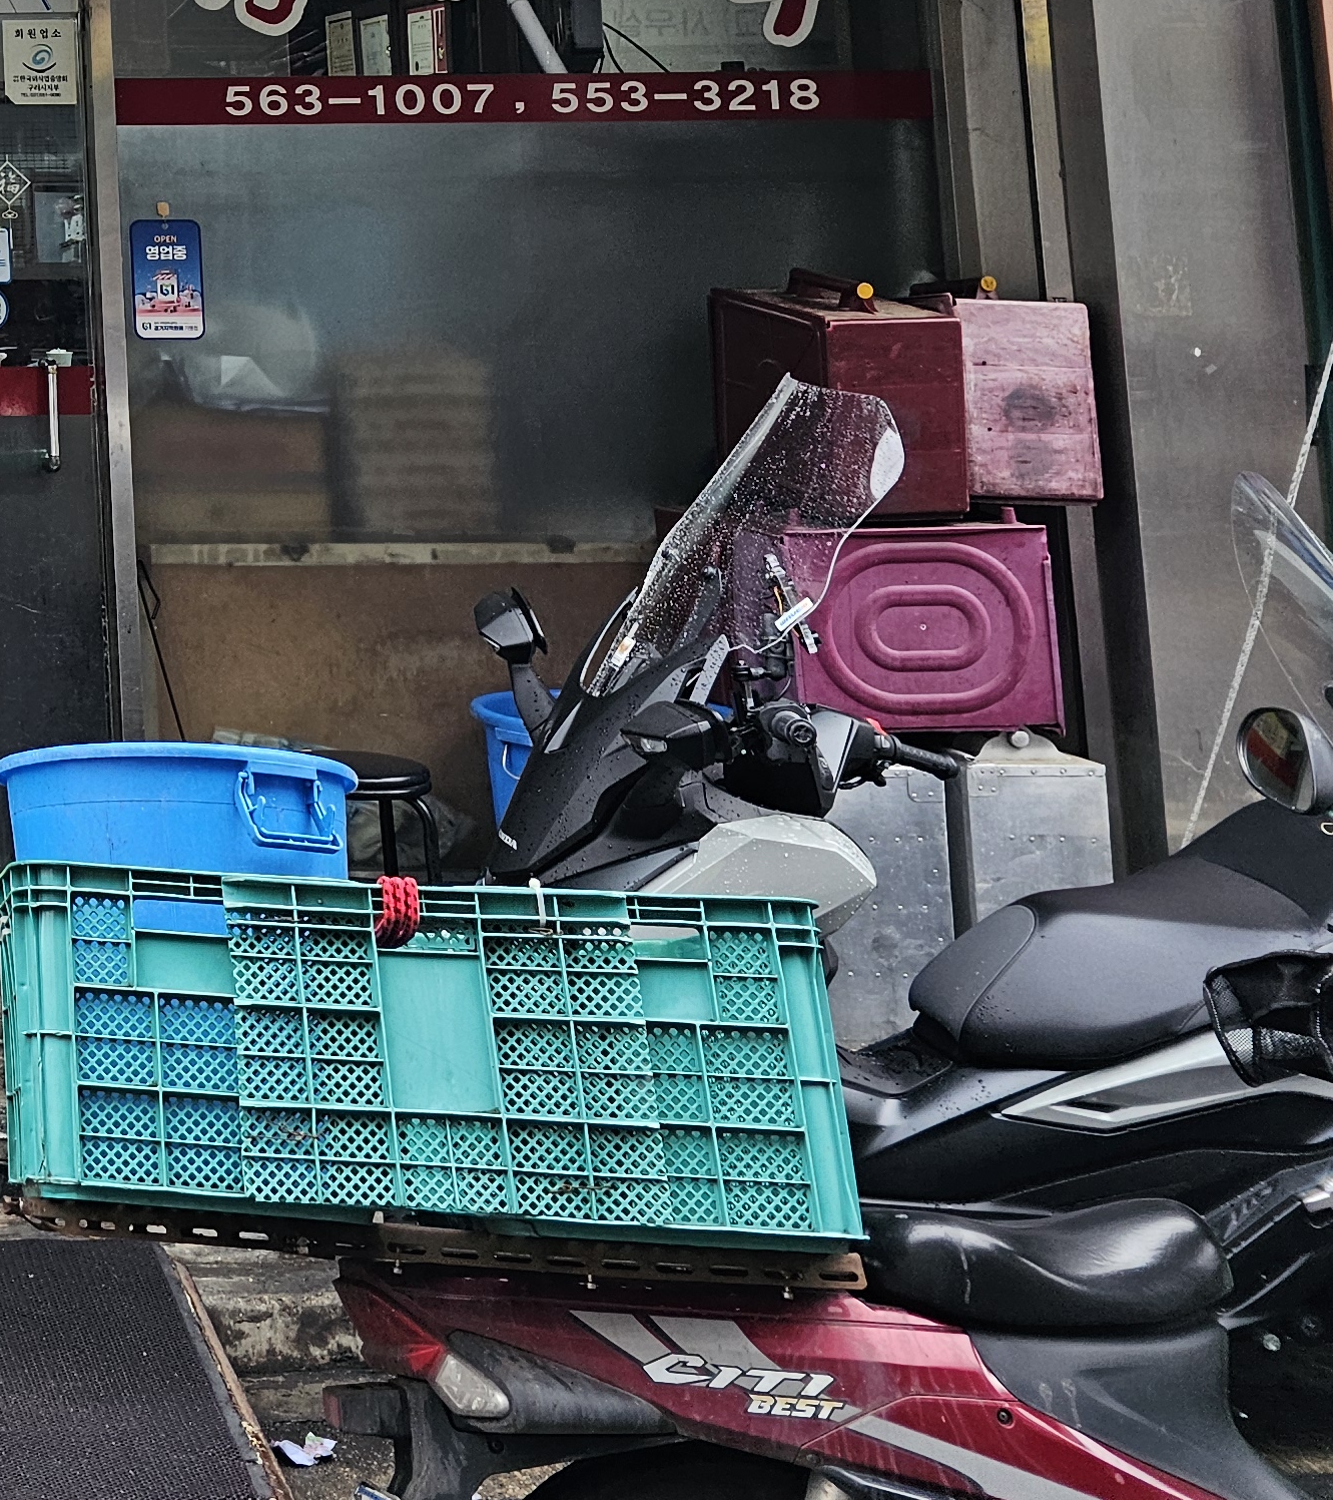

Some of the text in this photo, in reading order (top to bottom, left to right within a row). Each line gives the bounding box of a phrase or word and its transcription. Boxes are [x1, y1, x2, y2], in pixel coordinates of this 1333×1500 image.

[15, 28, 61, 39] 회원업소
[550, 77, 821, 113] 553-3218
[154, 235, 177, 243] OPEN
[145, 245, 187, 260] 영업중
[746, 1394, 844, 1420] BEST
